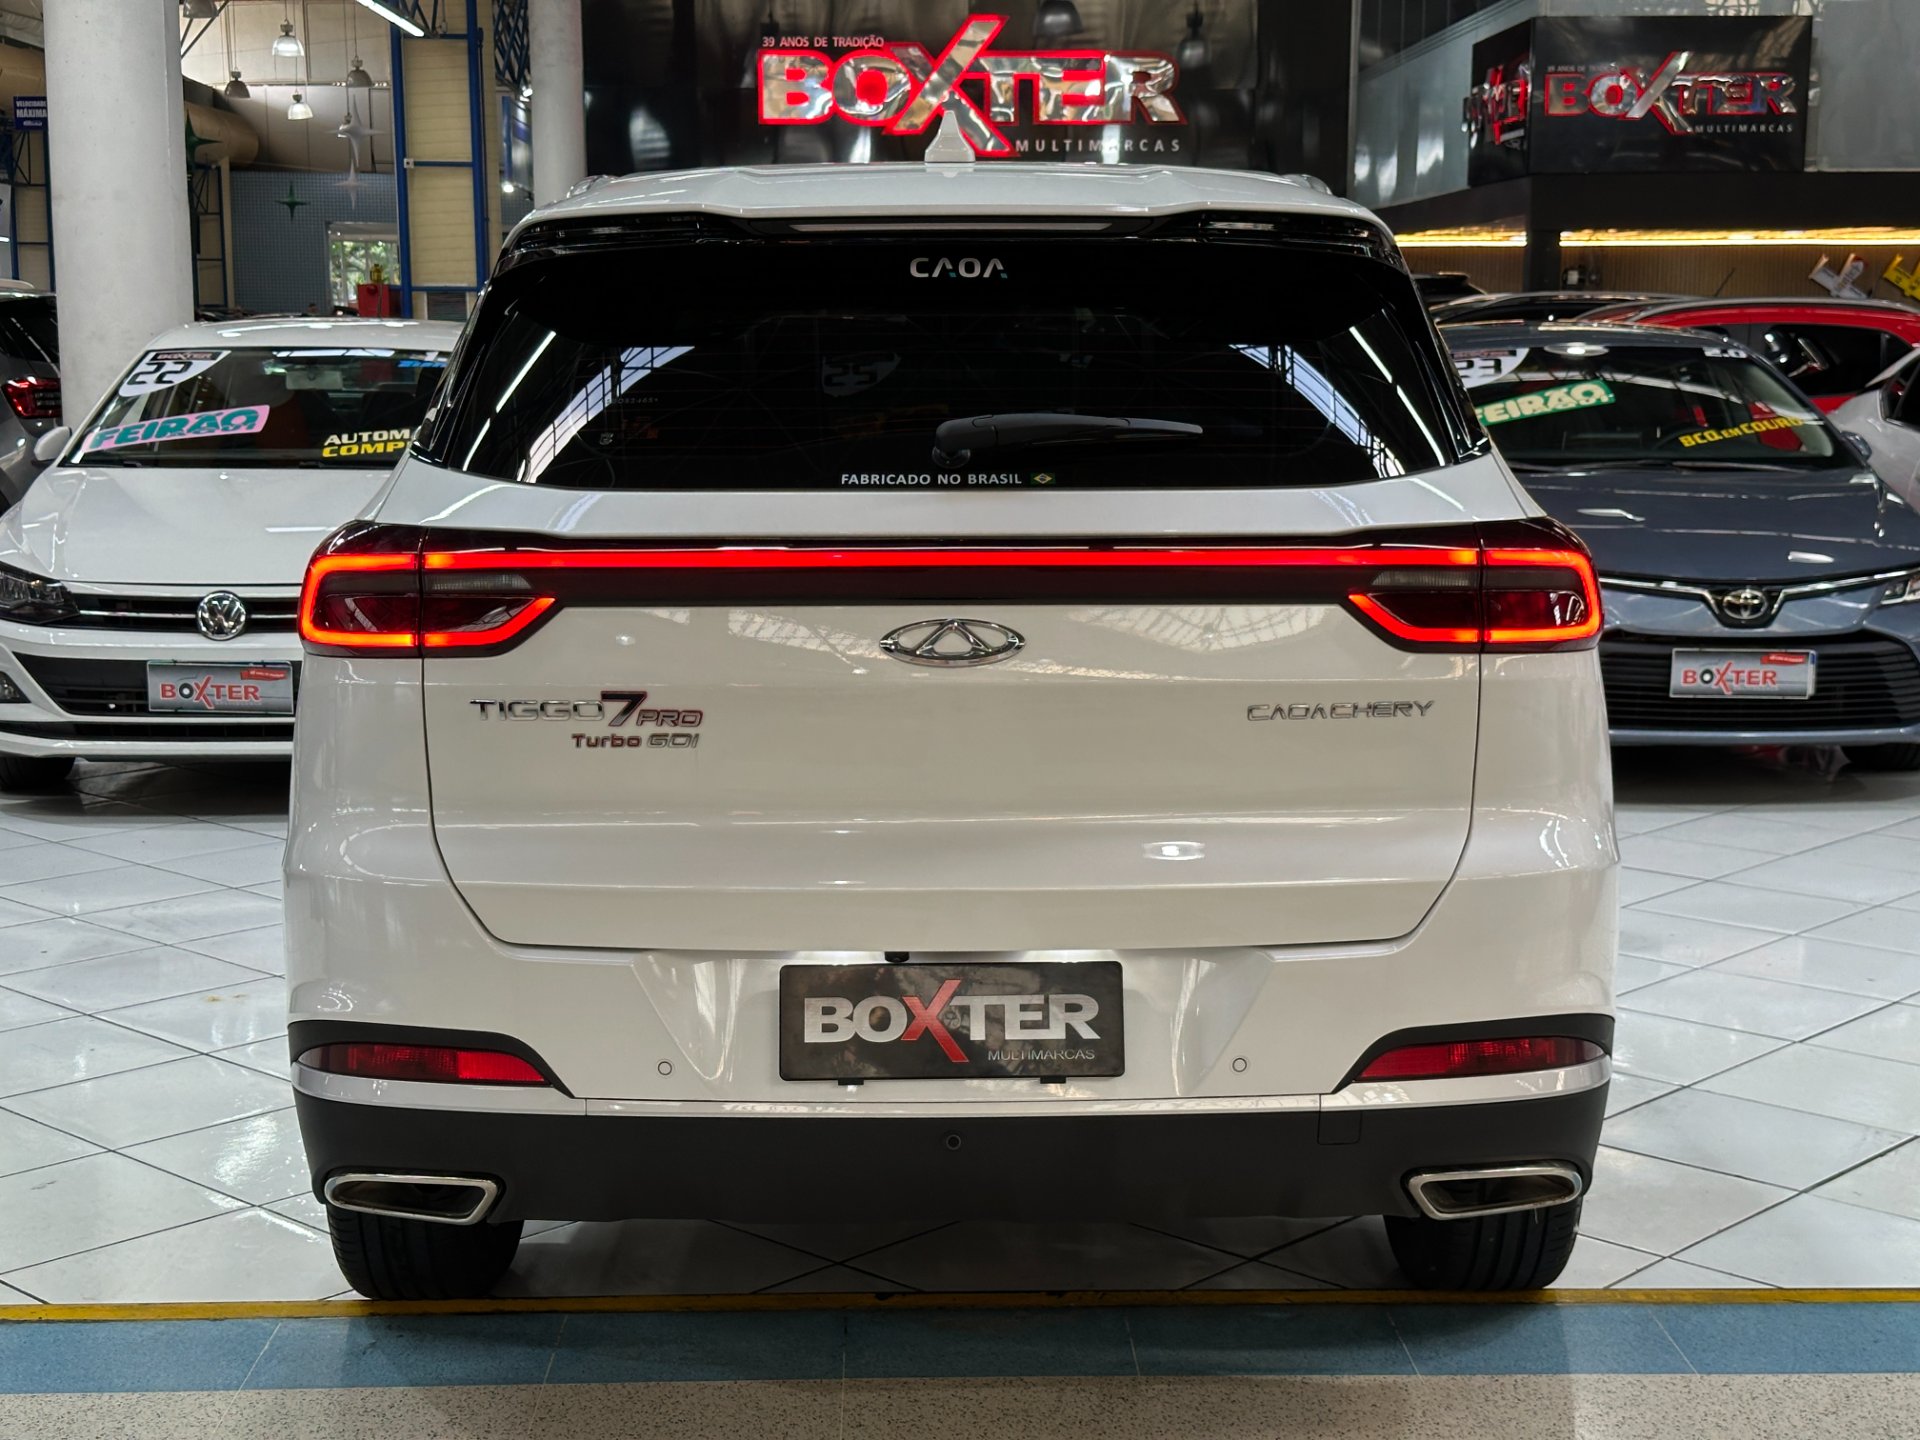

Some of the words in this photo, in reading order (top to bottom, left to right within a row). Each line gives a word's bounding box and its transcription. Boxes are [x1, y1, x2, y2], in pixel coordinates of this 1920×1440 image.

[762, 36, 775, 48] 39
[779, 36, 809, 48] ANOS
[814, 36, 829, 48] DE
[832, 35, 885, 49] TRADIÇÃO
[758, 14, 1188, 157] BOXTER
[1544, 50, 1797, 135] BOXTER
[1694, 124, 1793, 133] MULTIMARCAS
[909, 257, 1008, 279] CAOA
[127, 361, 193, 386] 22
[89, 408, 260, 449] FEIRÃO
[1740, 417, 1804, 434] COURO
[841, 473, 931, 485] FABRICADO
[937, 473, 961, 485] NO
[967, 473, 1022, 485] BRASIL
[1681, 660, 1778, 695] BOXTER
[160, 675, 261, 709] BOXTER
[571, 732, 643, 749] Turbo
[803, 979, 1101, 1063] BOXTER
[987, 1049, 1096, 1061] MULTIMARCAS
